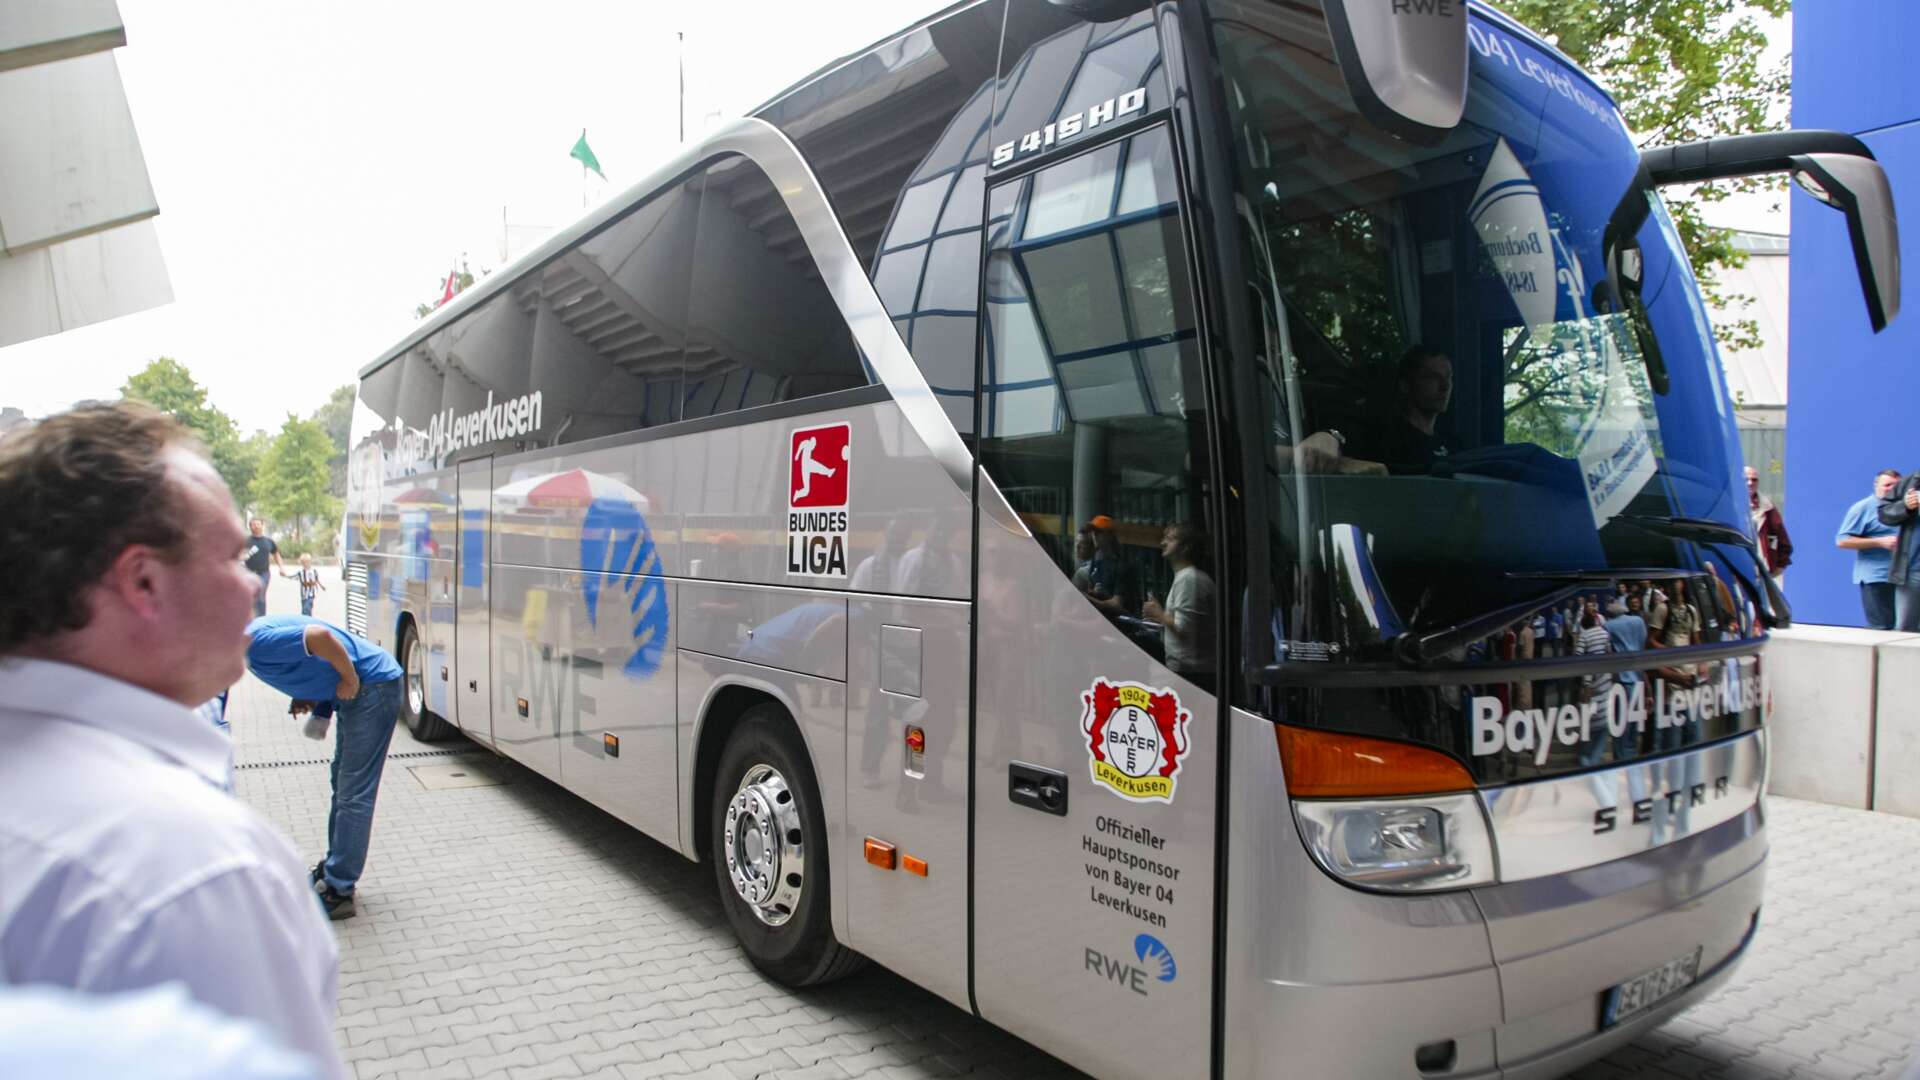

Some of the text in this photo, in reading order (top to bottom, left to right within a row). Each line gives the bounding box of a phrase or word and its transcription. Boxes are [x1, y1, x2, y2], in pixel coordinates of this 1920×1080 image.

[1391, 0, 1454, 17] RWE
[992, 88, 1146, 167] S 415 HD
[429, 411, 446, 458] 04
[448, 390, 542, 451] Leverkusen
[789, 511, 847, 532] BUNDES
[788, 535, 847, 576] LIGA
[1122, 690, 1146, 704] 1904
[1472, 666, 1762, 767] Bayer 04 Leverkuse
[1109, 731, 1156, 752] BAYER
[1126, 709, 1138, 774] BAYER
[1096, 764, 1167, 793] Leverkusen
[1593, 775, 1729, 835] SETRA
[1095, 815, 1166, 851] Offizieller
[1082, 834, 1180, 881] Hauptsponsor
[1085, 863, 1174, 905] von Bayer 04
[1091, 886, 1166, 928] Leverkusen
[1085, 947, 1148, 996] RWE
